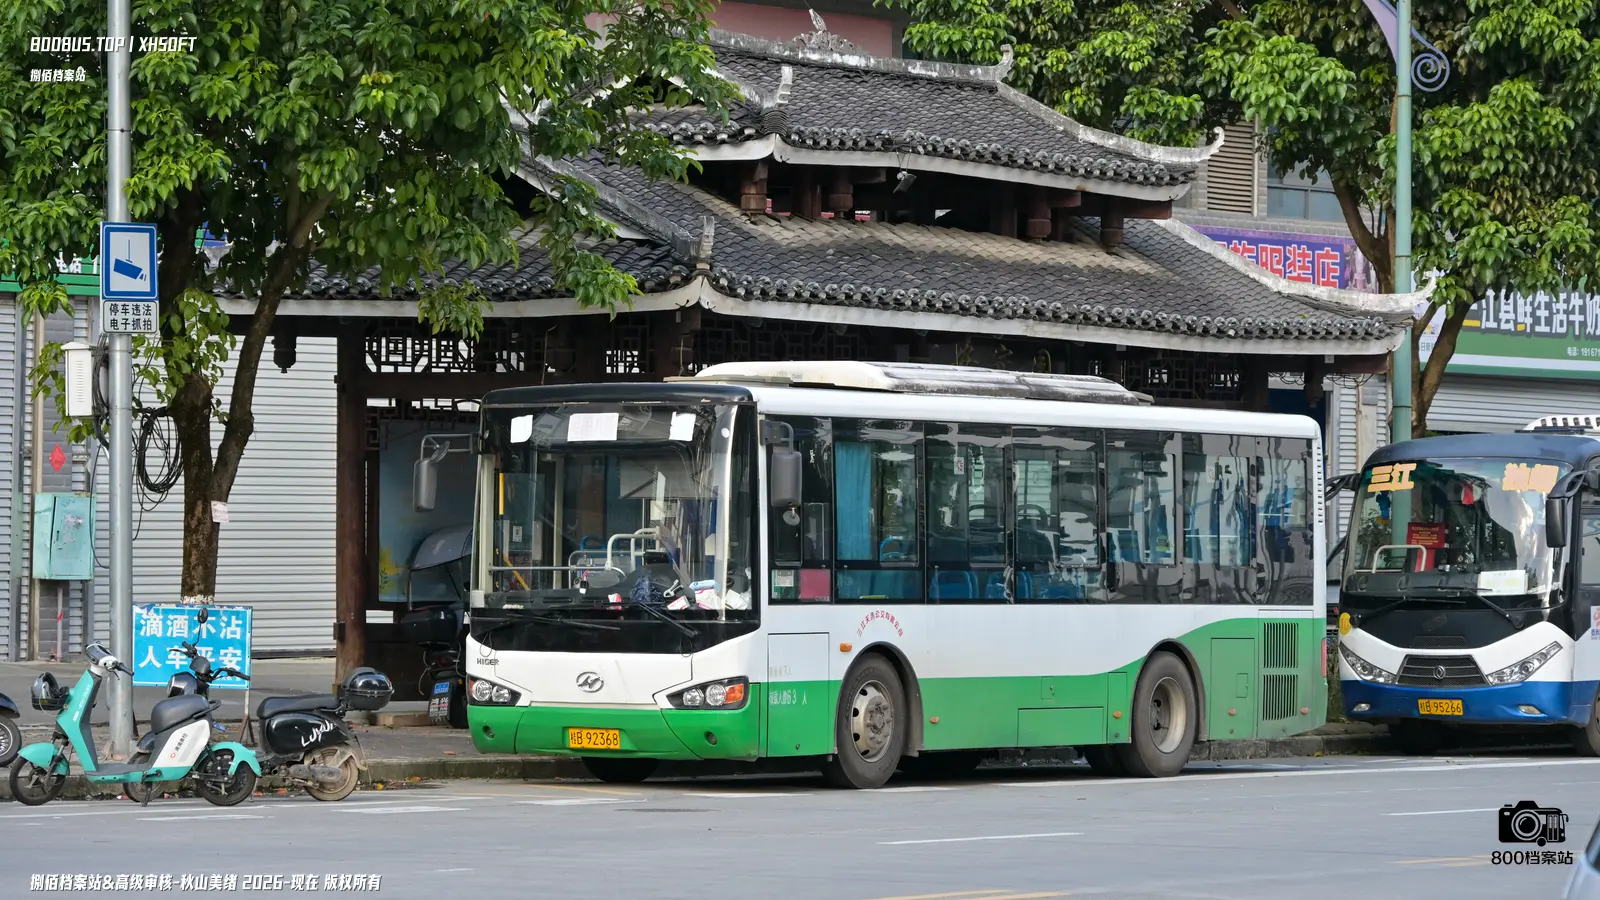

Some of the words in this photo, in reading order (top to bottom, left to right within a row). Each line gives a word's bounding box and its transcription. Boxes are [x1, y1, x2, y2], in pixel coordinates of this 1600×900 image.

[109, 303, 152, 316] 停车违法
[109, 318, 152, 330] 电子抓拍
[1368, 463, 1417, 492] 三江
[139, 612, 242, 639] 滴酒不沾
